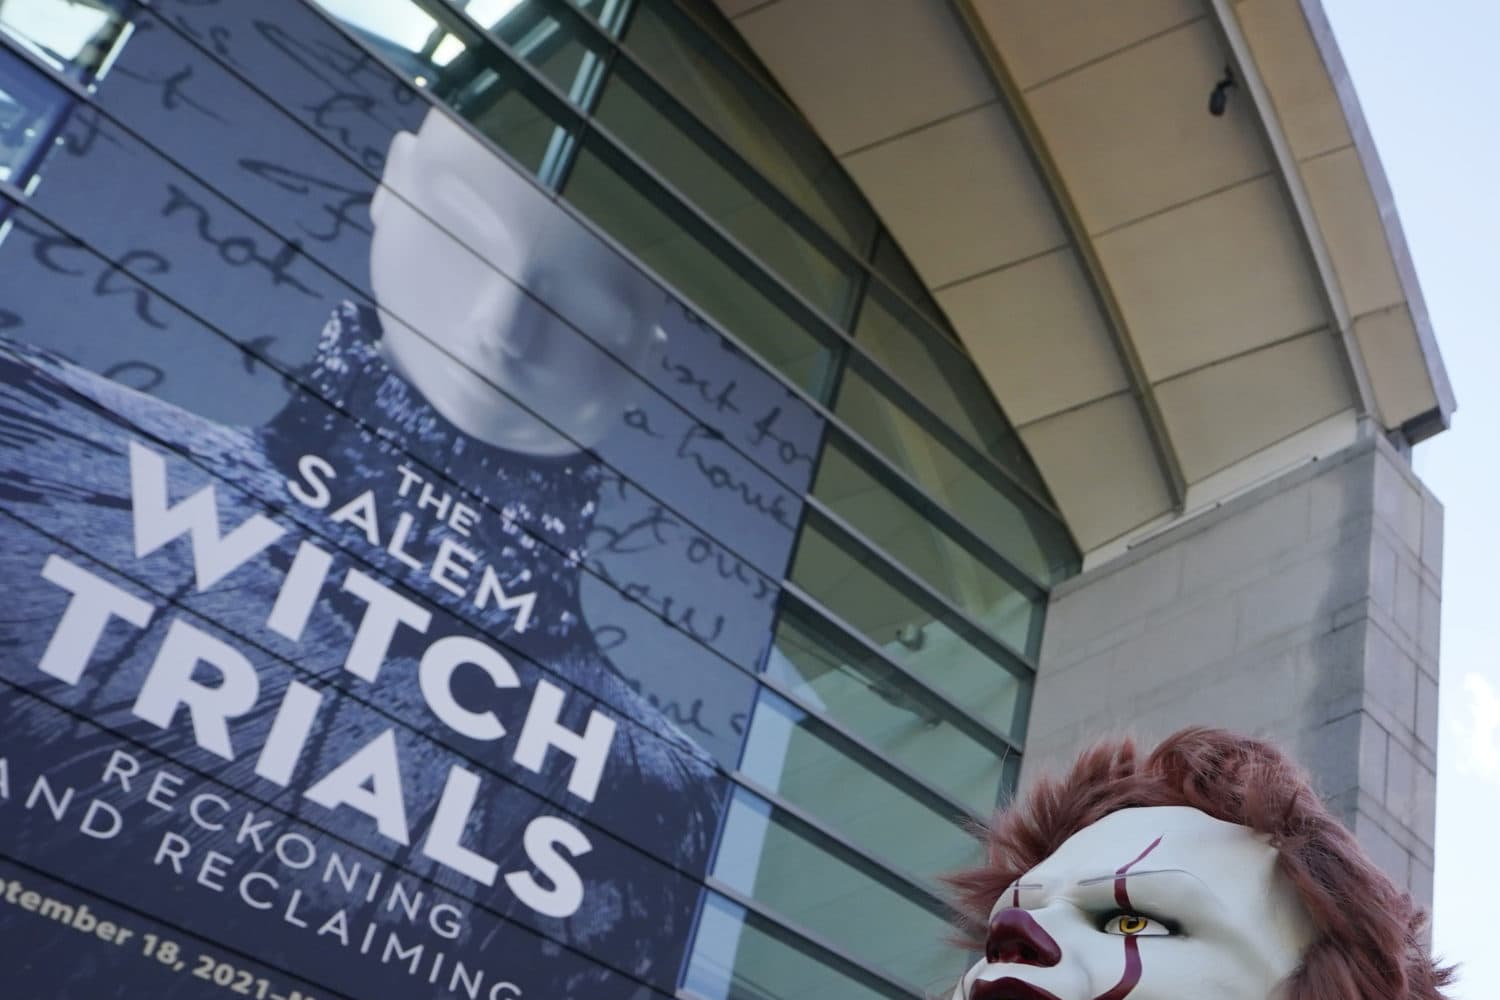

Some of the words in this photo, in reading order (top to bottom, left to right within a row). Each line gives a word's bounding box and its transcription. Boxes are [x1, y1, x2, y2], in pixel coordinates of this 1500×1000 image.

[287, 454, 538, 634] SALEM
[397, 465, 483, 536] THE
[128, 439, 617, 802] WITCH
[38, 553, 594, 919] TRIALS
[0, 876, 135, 946] tember
[142, 933, 186, 972] 18,
[102, 749, 463, 940] RECKONING
